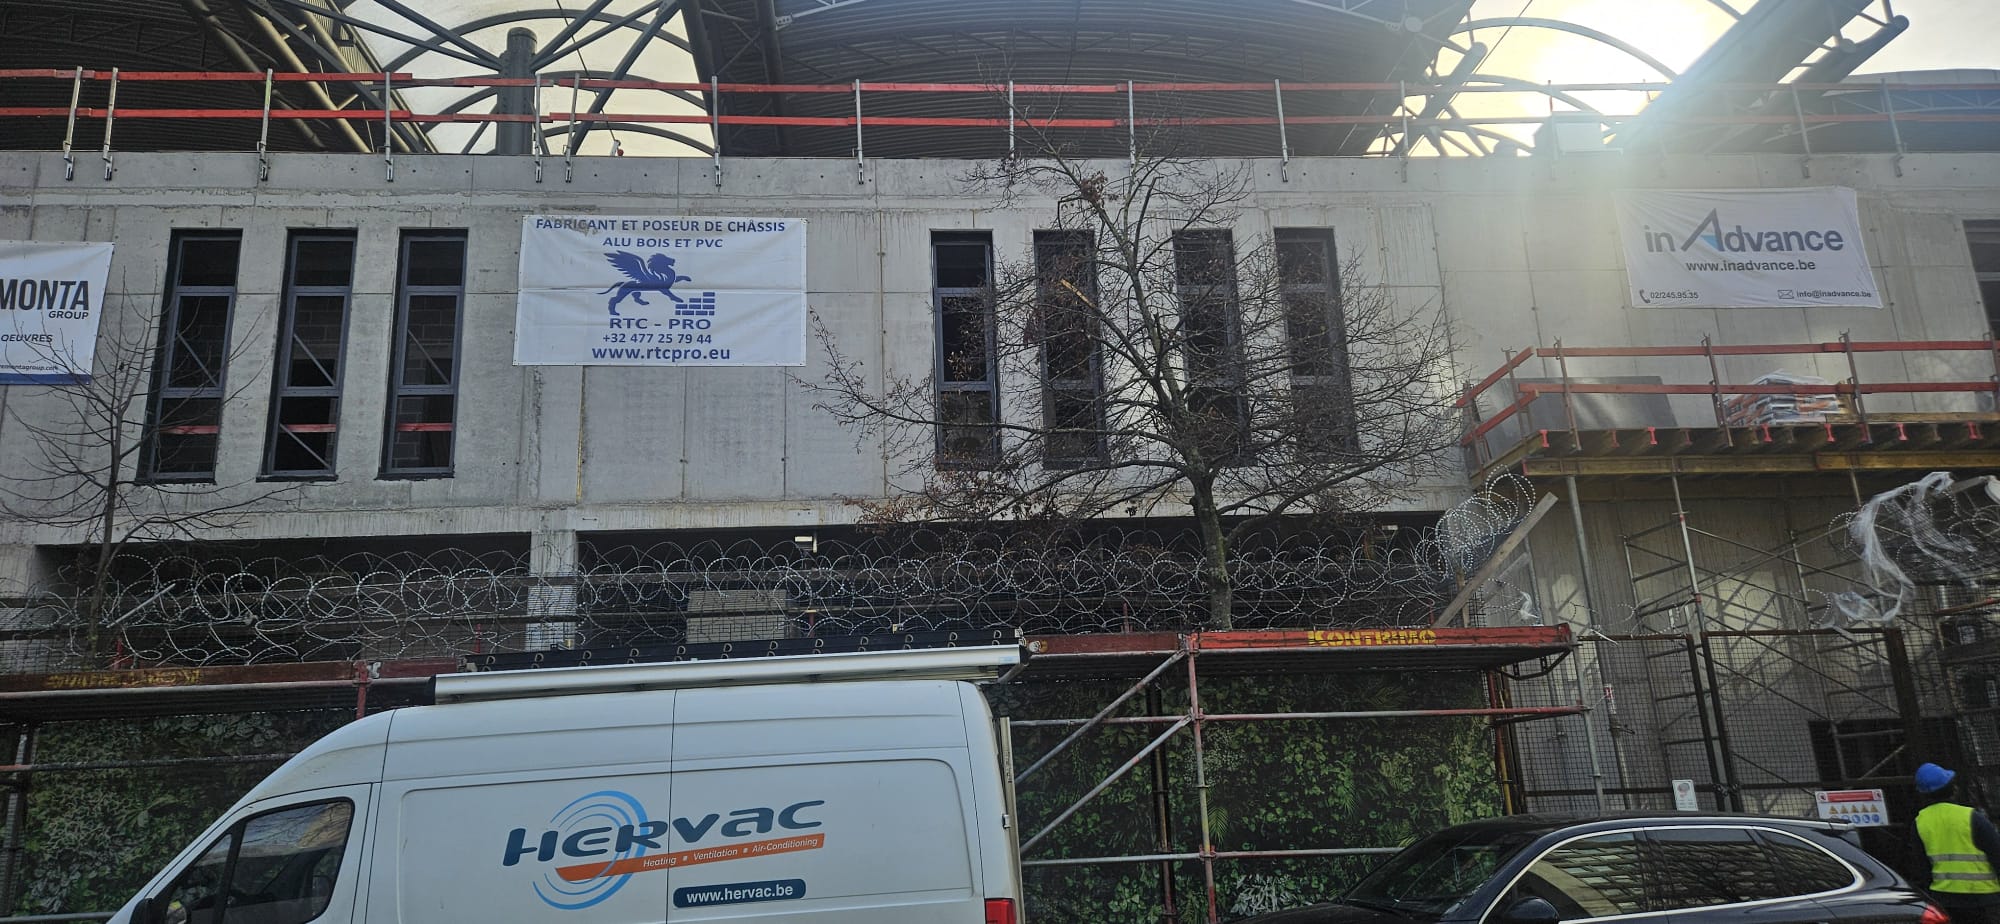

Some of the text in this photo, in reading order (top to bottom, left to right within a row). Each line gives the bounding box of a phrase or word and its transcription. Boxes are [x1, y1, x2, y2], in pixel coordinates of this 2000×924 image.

[536, 218, 785, 232] FABRICANT ET POSEUR DE CHÂSSIS
[603, 237, 723, 248] ALU BOIS ET PVC
[1686, 260, 1816, 272] www.inadvance.be
[1796, 290, 1872, 298] info@inadvance.be
[48, 311, 89, 320] GROUP
[609, 318, 648, 330] RTC
[668, 318, 711, 330] PRO
[1, 334, 53, 342] OEUVRES
[603, 333, 712, 344] +32 477 25 79 44
[592, 347, 730, 362] www.rtcpro.eu
[643, 837, 819, 868] Heating Ventilation Air-Conditioning
[687, 885, 794, 904] www.hervac.be
